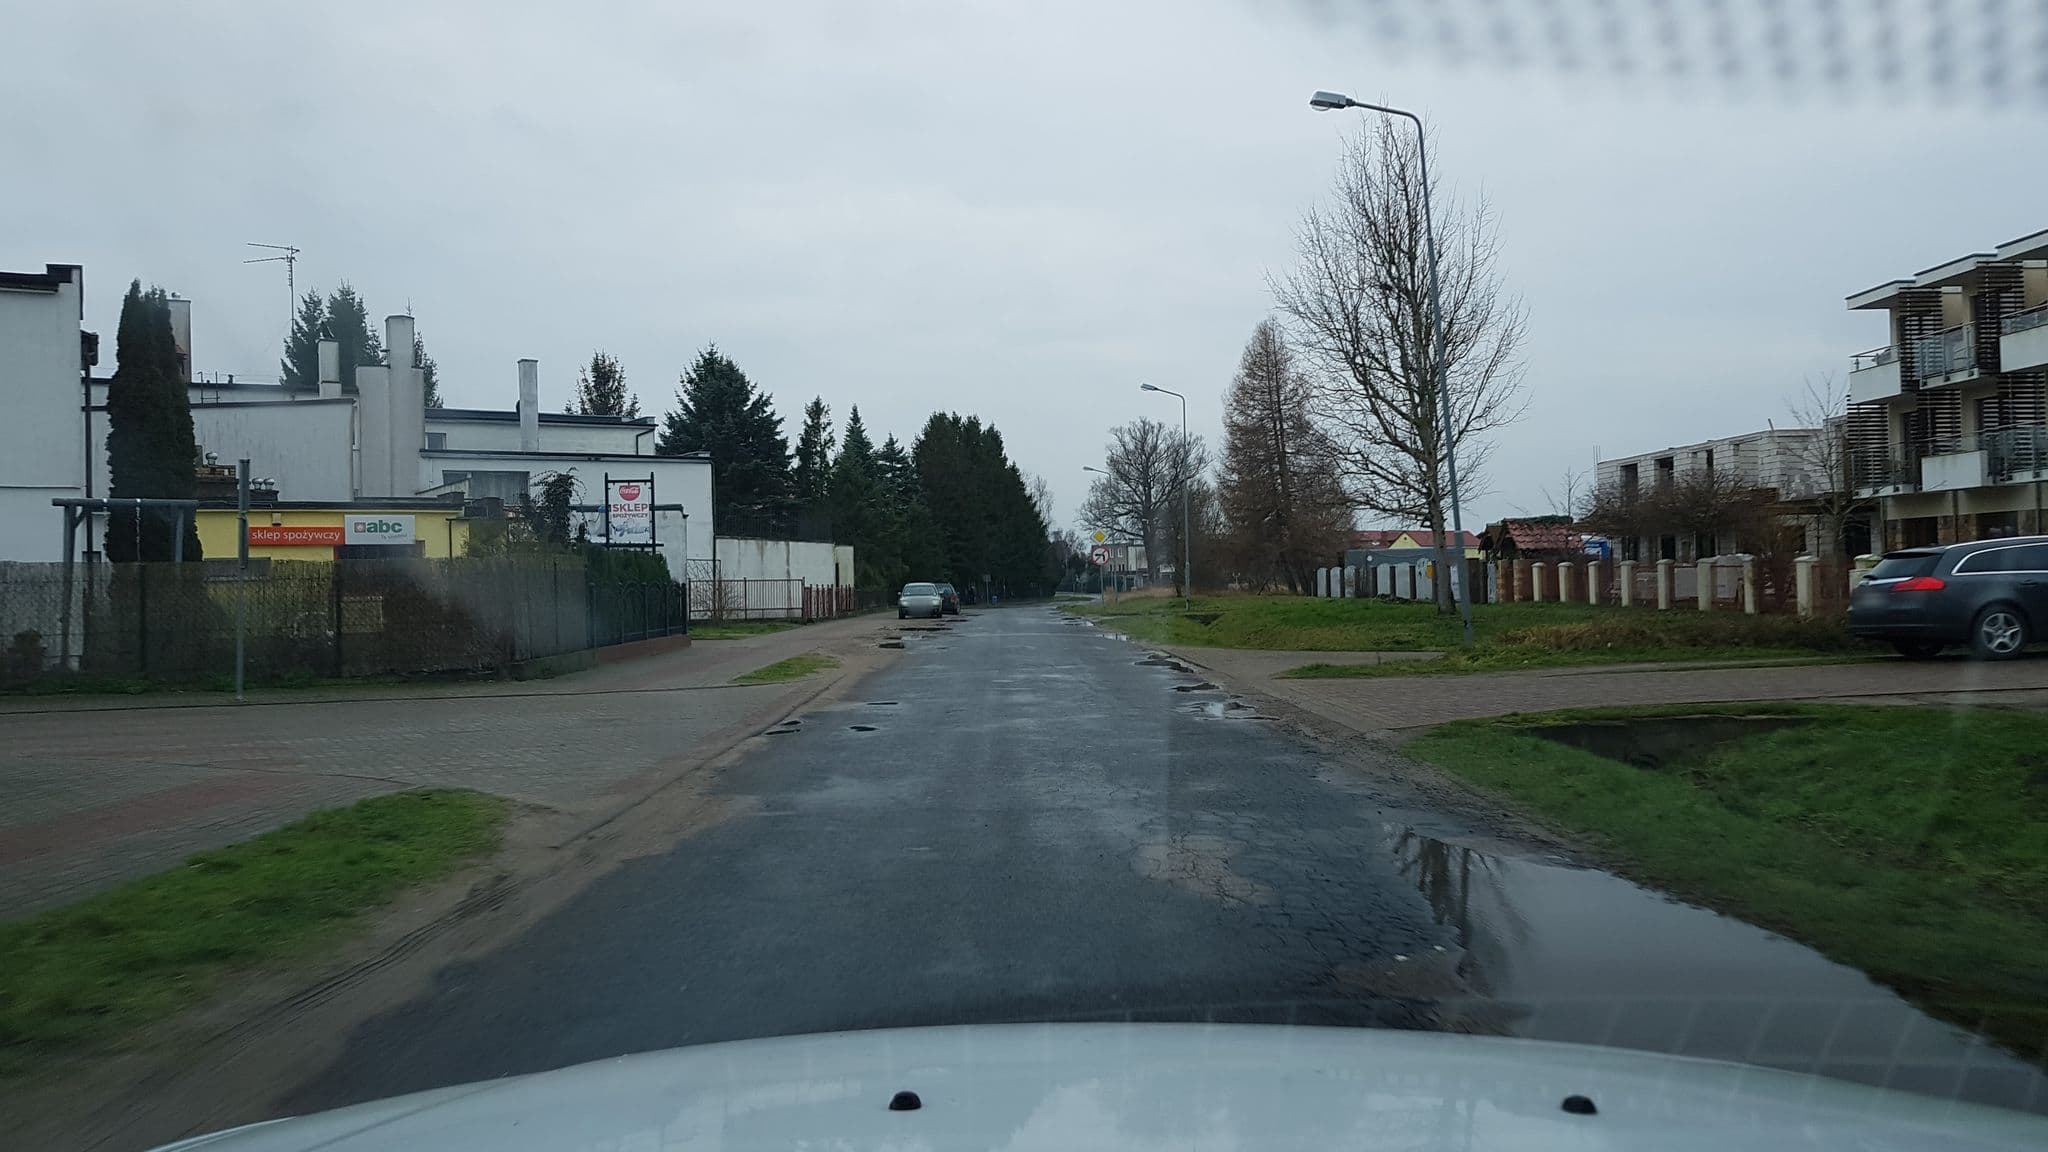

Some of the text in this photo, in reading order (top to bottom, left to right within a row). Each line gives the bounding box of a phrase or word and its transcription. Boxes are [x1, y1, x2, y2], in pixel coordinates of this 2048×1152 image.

[612, 503, 648, 512] SKLEP
[367, 519, 403, 533] abc
[252, 529, 341, 541] sklep spożywczy
